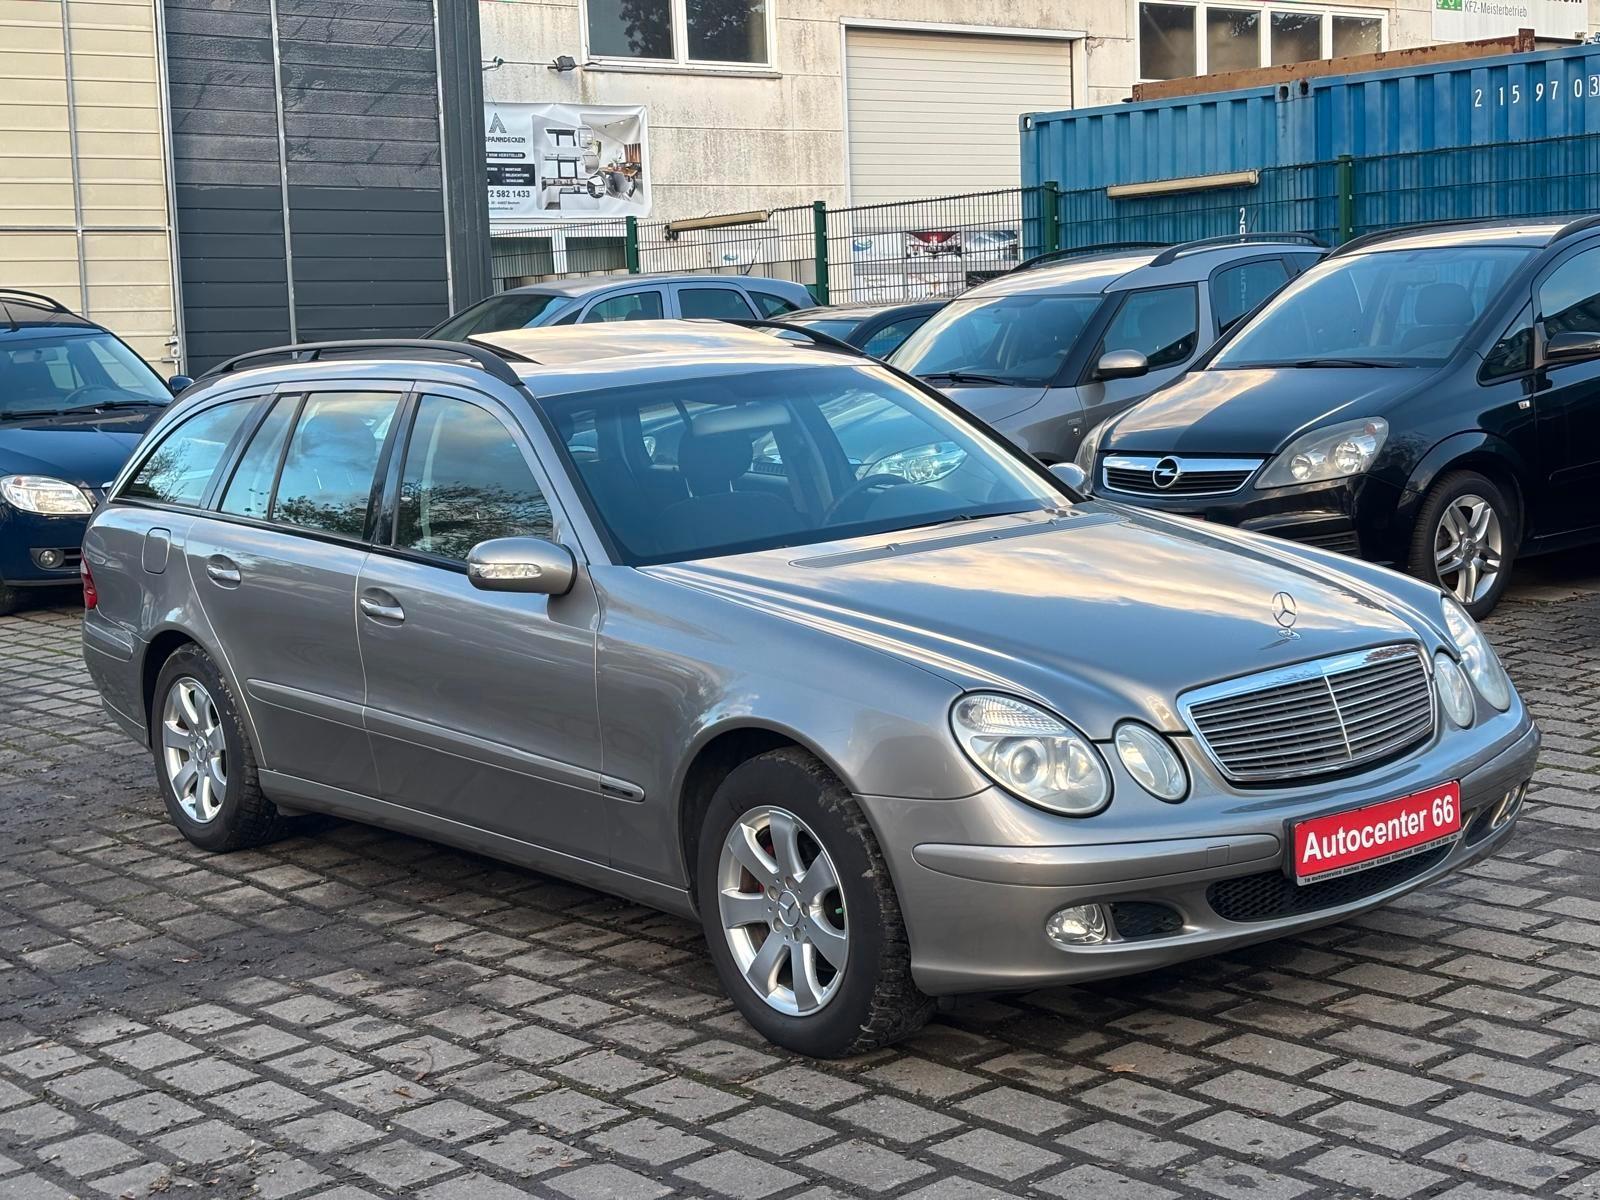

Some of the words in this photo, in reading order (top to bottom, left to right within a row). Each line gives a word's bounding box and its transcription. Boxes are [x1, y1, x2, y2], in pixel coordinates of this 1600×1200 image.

[1464, 2, 1528, 18] KFZ-Meisterbetrieb
[496, 189, 510, 198] 582
[512, 190, 530, 198] 1433
[1302, 809, 1428, 863] Autocenter
[1432, 795, 1454, 827] 66
